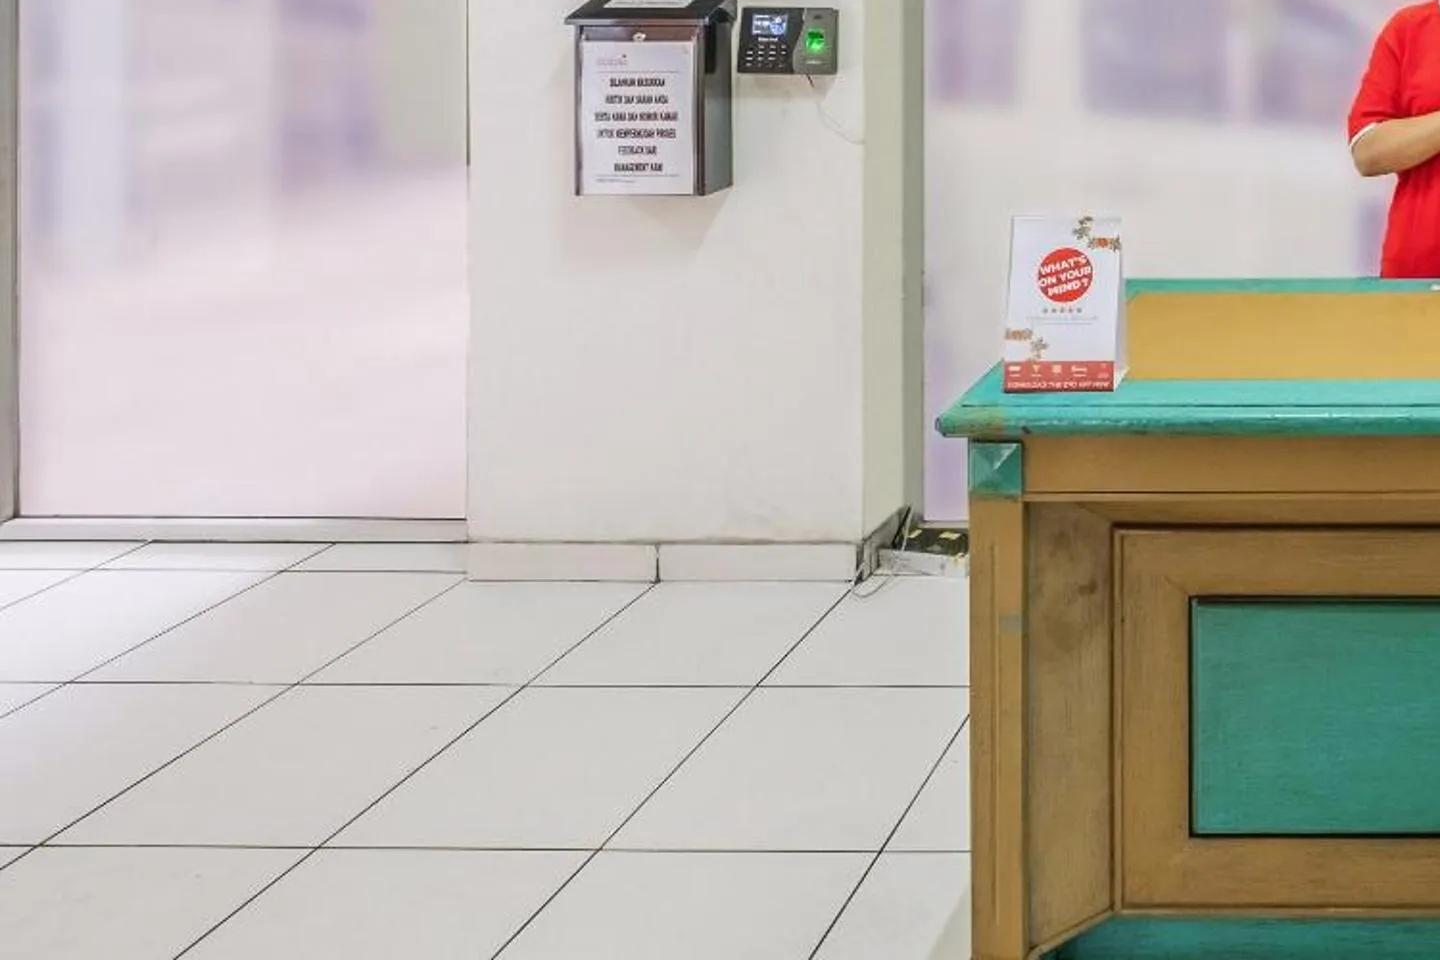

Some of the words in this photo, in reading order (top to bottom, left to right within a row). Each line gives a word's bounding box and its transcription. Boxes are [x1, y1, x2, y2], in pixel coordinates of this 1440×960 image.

[1040, 255, 1087, 275] WHAT'S
[1039, 275, 1057, 287] ON
[1059, 266, 1092, 282] YOUR
